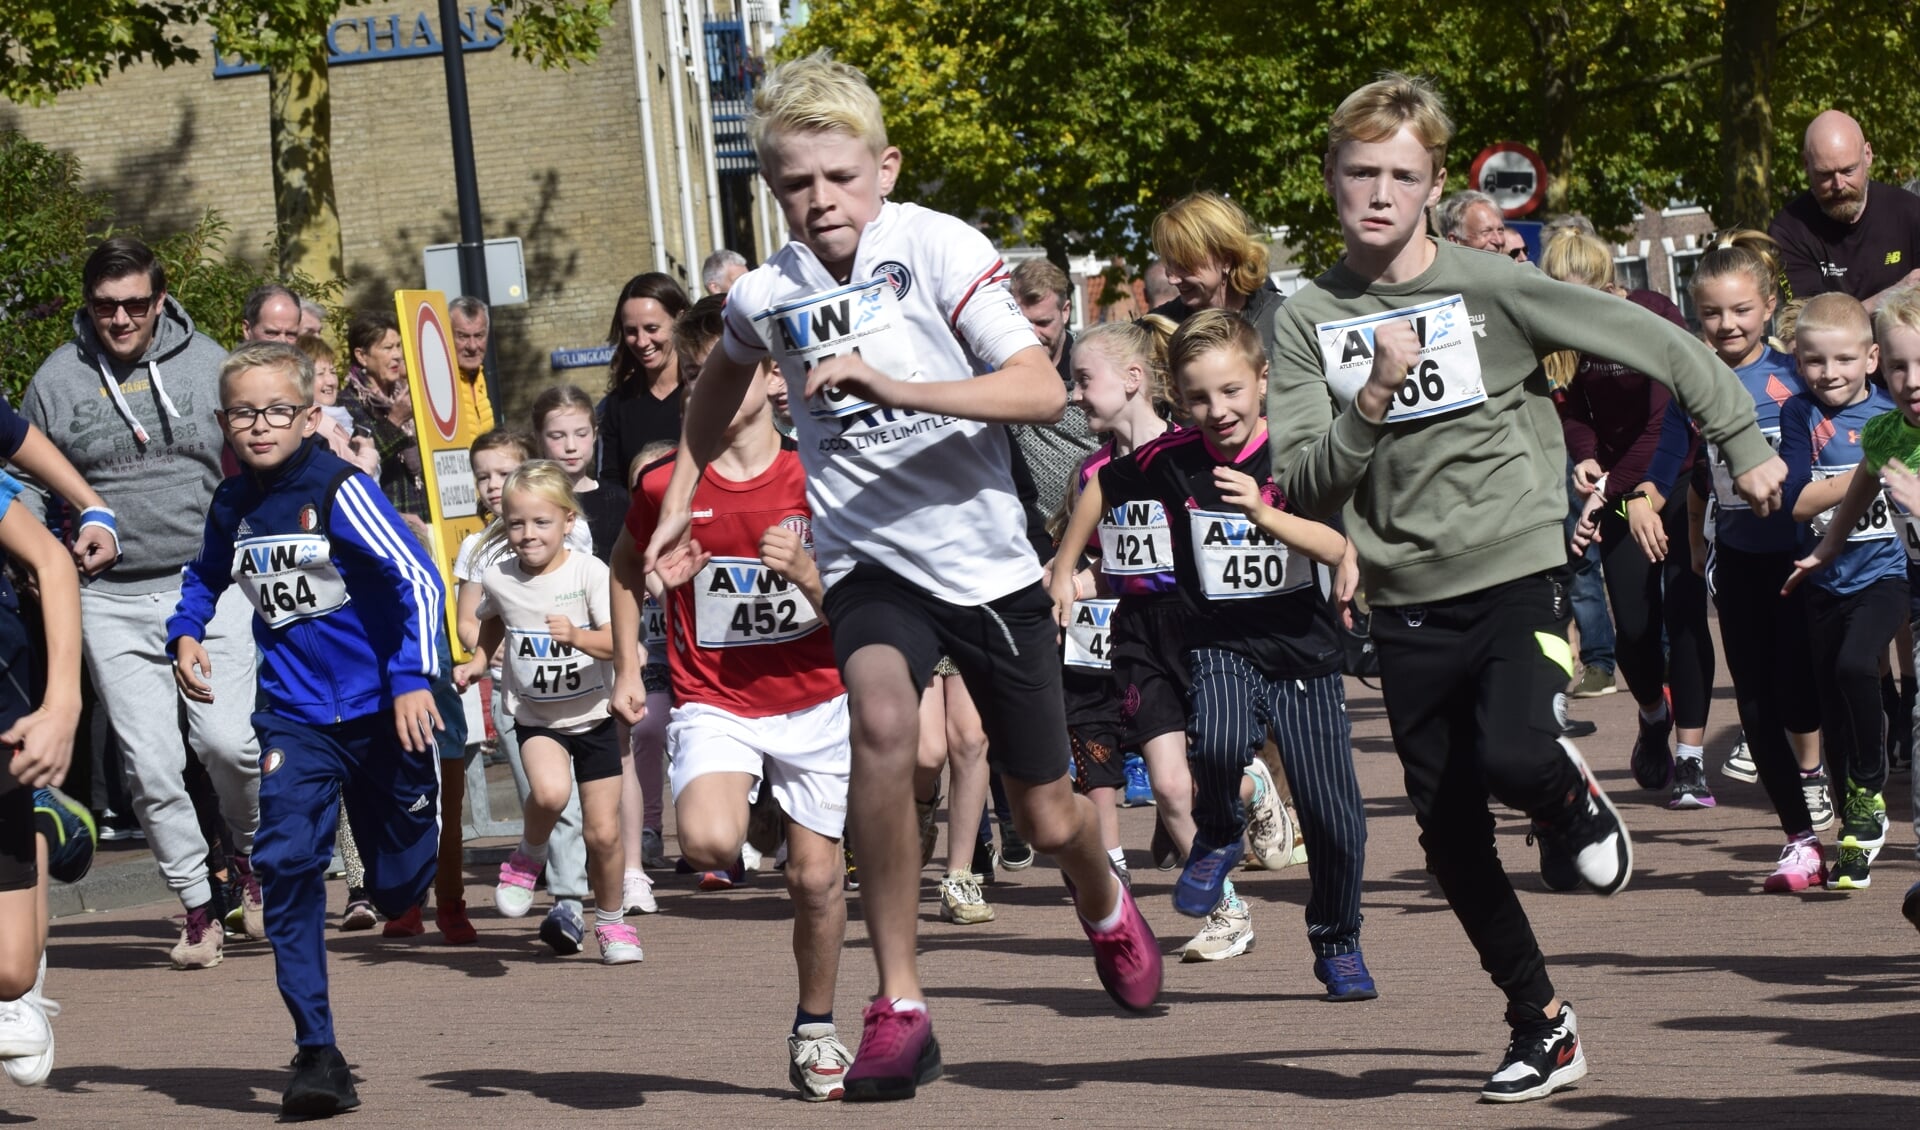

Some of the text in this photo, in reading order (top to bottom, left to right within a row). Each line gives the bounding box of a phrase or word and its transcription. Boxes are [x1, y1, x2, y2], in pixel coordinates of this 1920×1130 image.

[326, 5, 507, 56] CHANS
[777, 300, 850, 350] AVW
[555, 349, 615, 365] ELLINGKAD
[1431, 340, 1462, 352] MAASSLUIS
[1388, 359, 1445, 410] 66
[819, 437, 852, 453] ACCO
[857, 429, 889, 450] LIVE
[893, 416, 963, 441] LIMITLE
[1102, 503, 1150, 526] AVW
[1203, 521, 1277, 546] AVW
[240, 544, 298, 575] AVW
[1116, 533, 1157, 566] 421
[709, 567, 788, 594] AVW
[1222, 554, 1283, 589] 450
[260, 574, 317, 619] 464
[731, 599, 799, 637] 452
[1076, 606, 1115, 626] AV
[518, 637, 573, 658] AVW
[533, 662, 581, 693] 475
